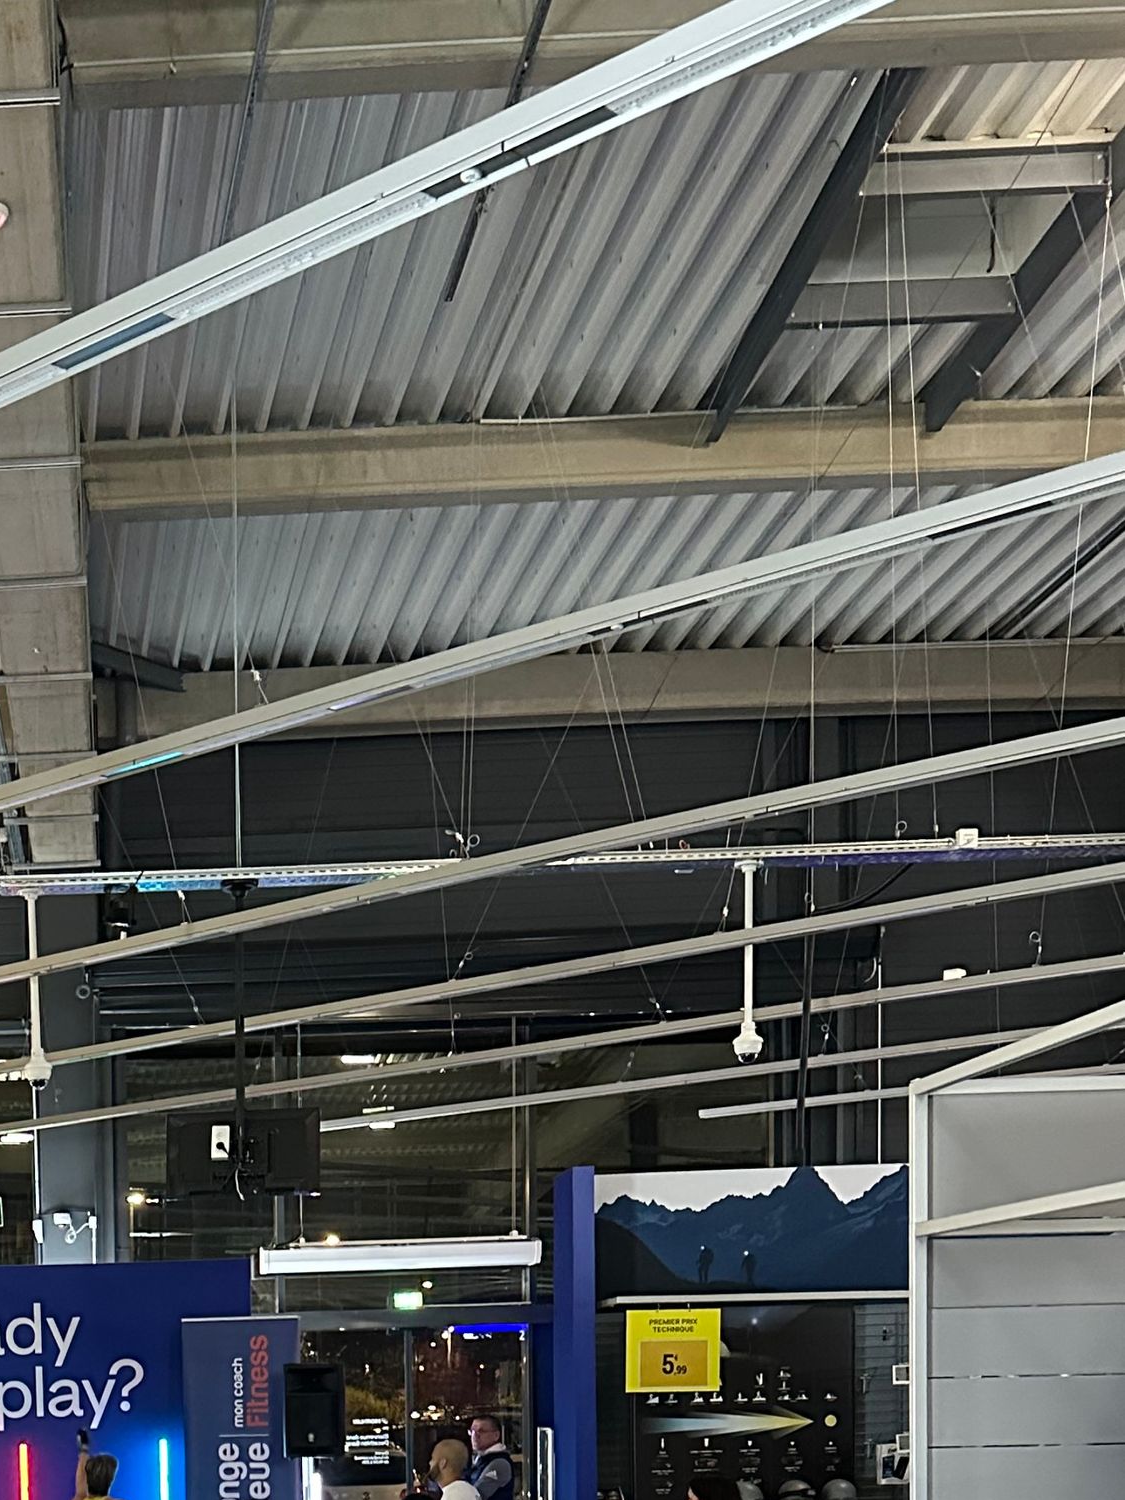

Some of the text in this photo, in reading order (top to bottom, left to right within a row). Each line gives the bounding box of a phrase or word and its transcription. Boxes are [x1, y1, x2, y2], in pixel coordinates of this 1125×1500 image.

[649, 1318, 680, 1326] PREMIER
[231, 1357, 244, 1428] mon coach
[246, 1334, 269, 1429] Fitness
